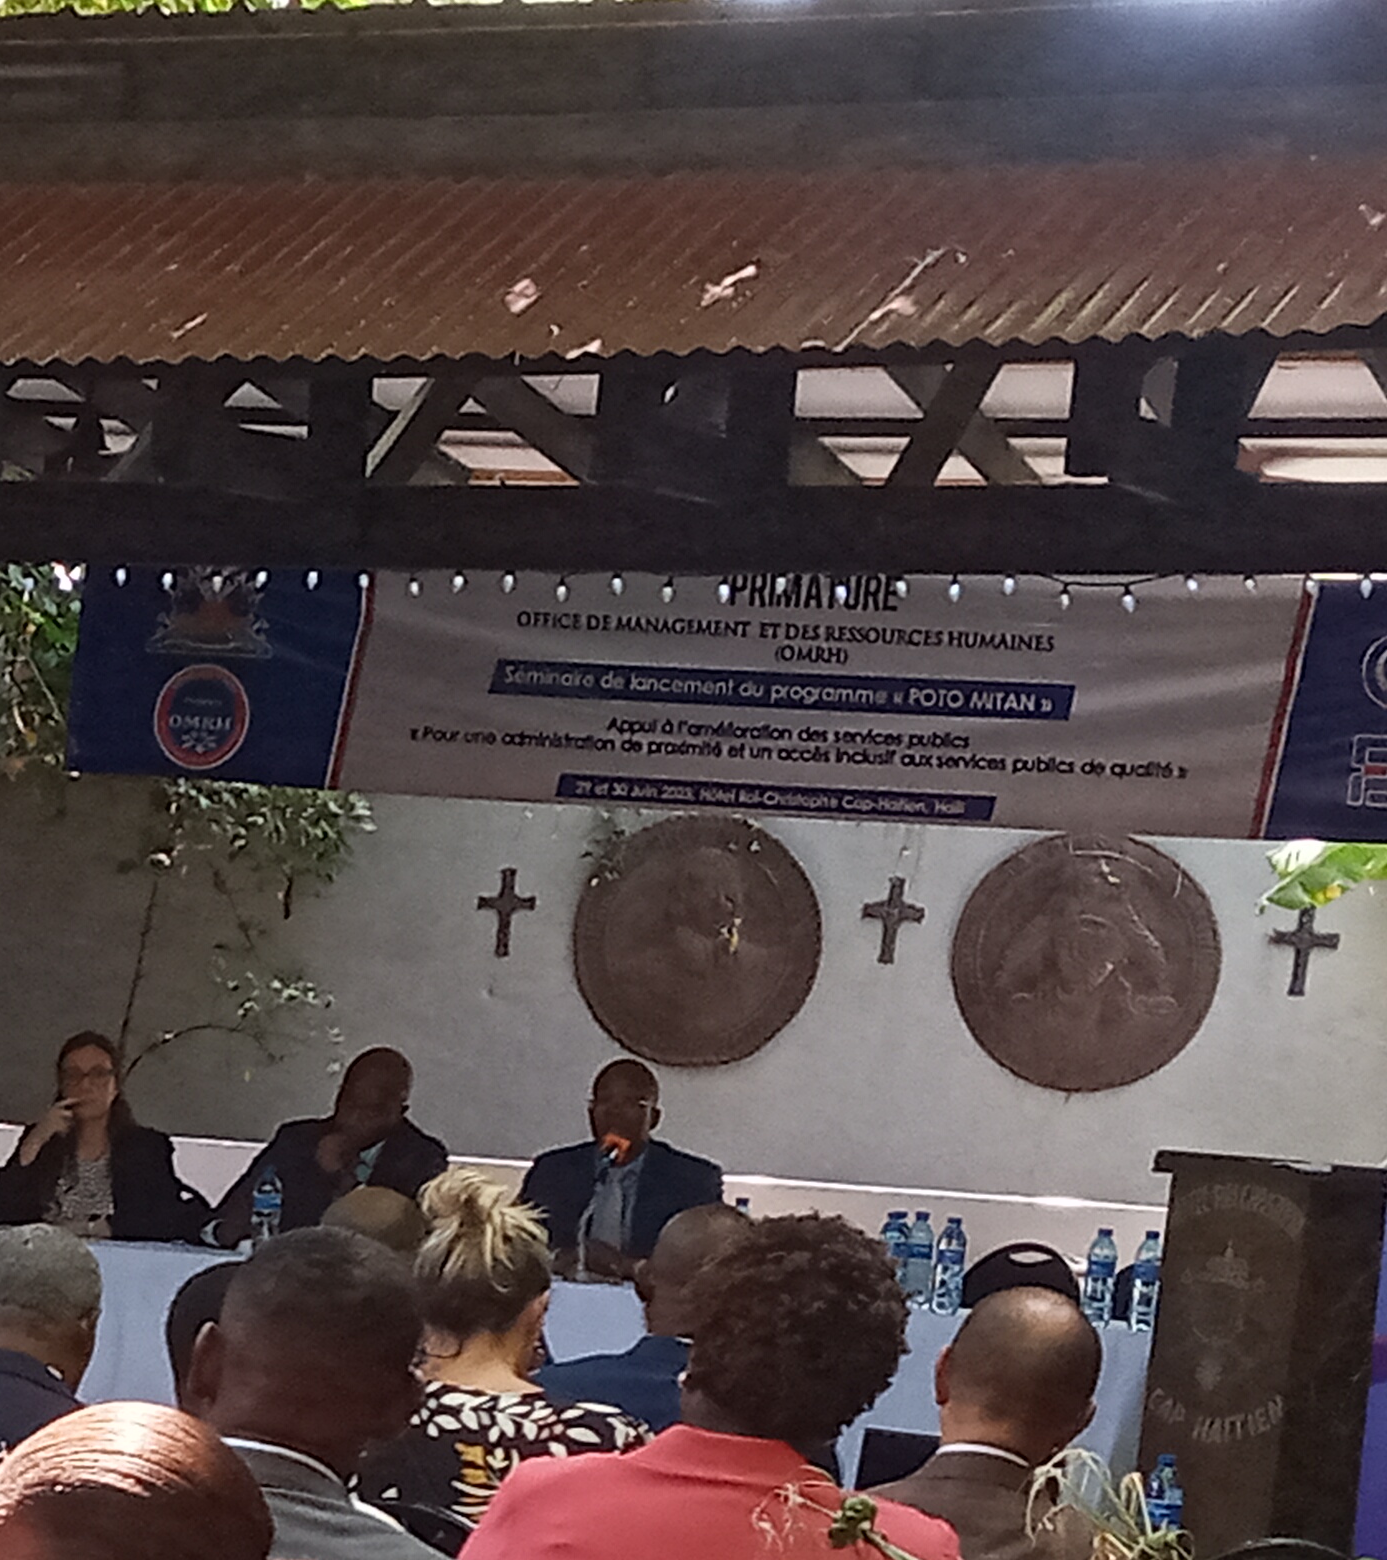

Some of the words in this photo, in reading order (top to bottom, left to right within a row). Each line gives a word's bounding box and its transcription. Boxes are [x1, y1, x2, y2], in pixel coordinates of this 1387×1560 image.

[729, 574, 899, 611] PRIMATURE
[516, 611, 581, 630] OFFICE
[585, 615, 613, 631] DE
[615, 617, 751, 639] MANAGEMENT
[759, 622, 783, 640] ET
[784, 623, 821, 642] DES
[824, 626, 944, 647] RESSOURCES
[947, 631, 1055, 652] HUMAINES
[774, 644, 849, 665] (OMRH)
[503, 664, 595, 689] Séminaire
[600, 671, 625, 690] de
[629, 673, 735, 696] lancement
[738, 680, 764, 698] du
[770, 683, 887, 706] programme
[908, 688, 965, 709] POTO
[969, 692, 1036, 712] MITAN
[168, 715, 234, 732] OMRH
[606, 715, 657, 735] Appui
[661, 715, 675, 735] à
[798, 726, 829, 744] des
[833, 728, 903, 748] services
[907, 730, 970, 751] publics
[421, 726, 460, 744] Pour
[464, 729, 497, 746] une
[501, 731, 615, 752] administration
[620, 737, 644, 755] de
[647, 738, 723, 759] proximité
[727, 741, 747, 759] et
[750, 743, 772, 760] un
[777, 745, 831, 764] accès
[834, 747, 896, 766] inclusif
[900, 751, 934, 768] aux
[935, 752, 1006, 773] services
[1011, 755, 1075, 778] publics
[1080, 759, 1105, 777] de
[1109, 760, 1173, 780] qualité
